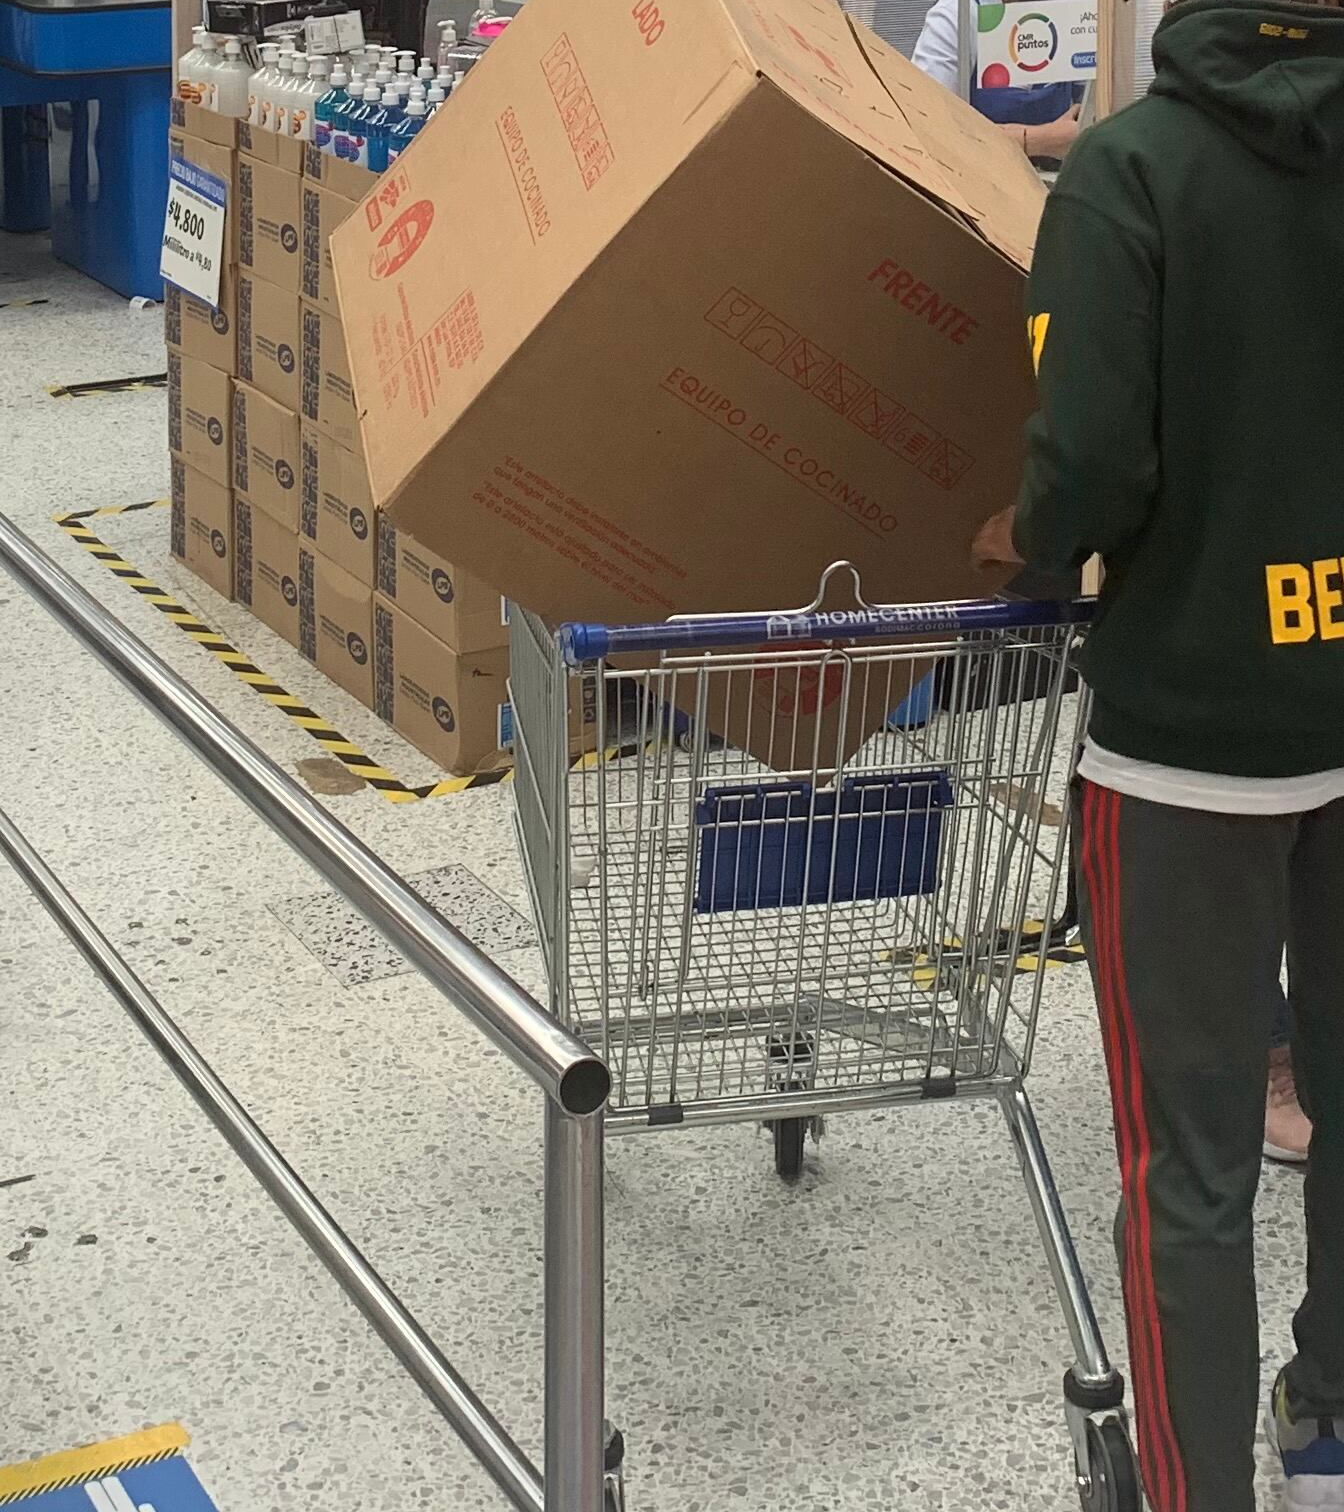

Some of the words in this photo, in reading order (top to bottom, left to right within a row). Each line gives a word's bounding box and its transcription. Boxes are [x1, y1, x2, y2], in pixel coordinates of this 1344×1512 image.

[1018, 39, 1049, 52] puntos
[1071, 25, 1086, 35] con
[499, 105, 522, 154] EQUIPO
[520, 167, 552, 237] COCINADO
[168, 197, 205, 240] $4.800
[865, 256, 980, 346] FRENTE
[666, 366, 747, 427] EQUIPO
[750, 421, 778, 450] DE
[782, 445, 898, 534] COCINADO
[815, 605, 958, 626] HOMECENTER
